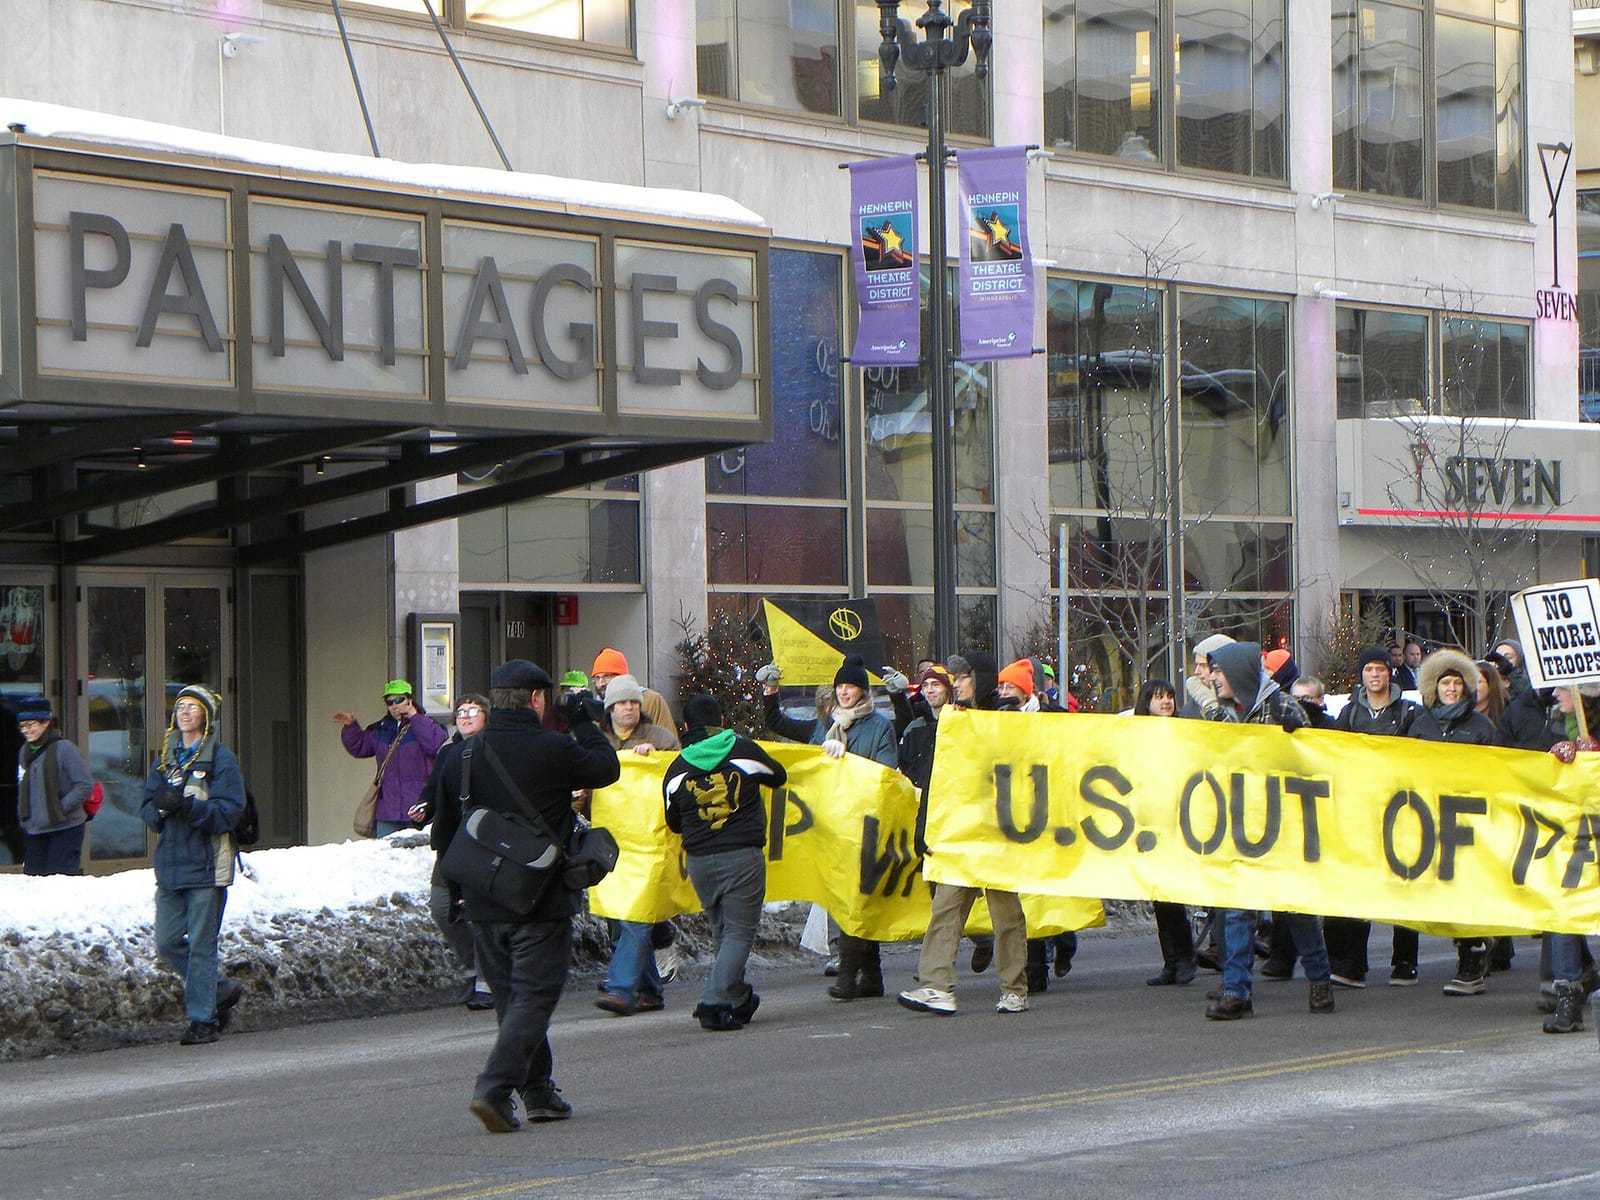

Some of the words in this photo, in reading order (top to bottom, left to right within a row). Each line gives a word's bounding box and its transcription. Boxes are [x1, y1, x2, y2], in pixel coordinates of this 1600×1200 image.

[859, 200, 913, 214] HENNEPIN
[968, 191, 1019, 205] HENNEPIN
[867, 271, 912, 285] THEATRE
[972, 263, 1022, 276] THEATRE
[869, 286, 912, 300] DISTRICT
[972, 278, 1023, 292] DISTRICT
[68, 211, 744, 391] PANTAGES
[1535, 289, 1580, 322] SEVEN
[1445, 454, 1562, 507] SEVEN
[1541, 592, 1573, 620] NO
[506, 620, 525, 638] 700
[1537, 622, 1596, 651] MORE
[1542, 651, 1600, 676] TROOPS
[994, 763, 1158, 853] U.S.
[1179, 769, 1330, 863] OUT
[1382, 789, 1487, 881] OF
